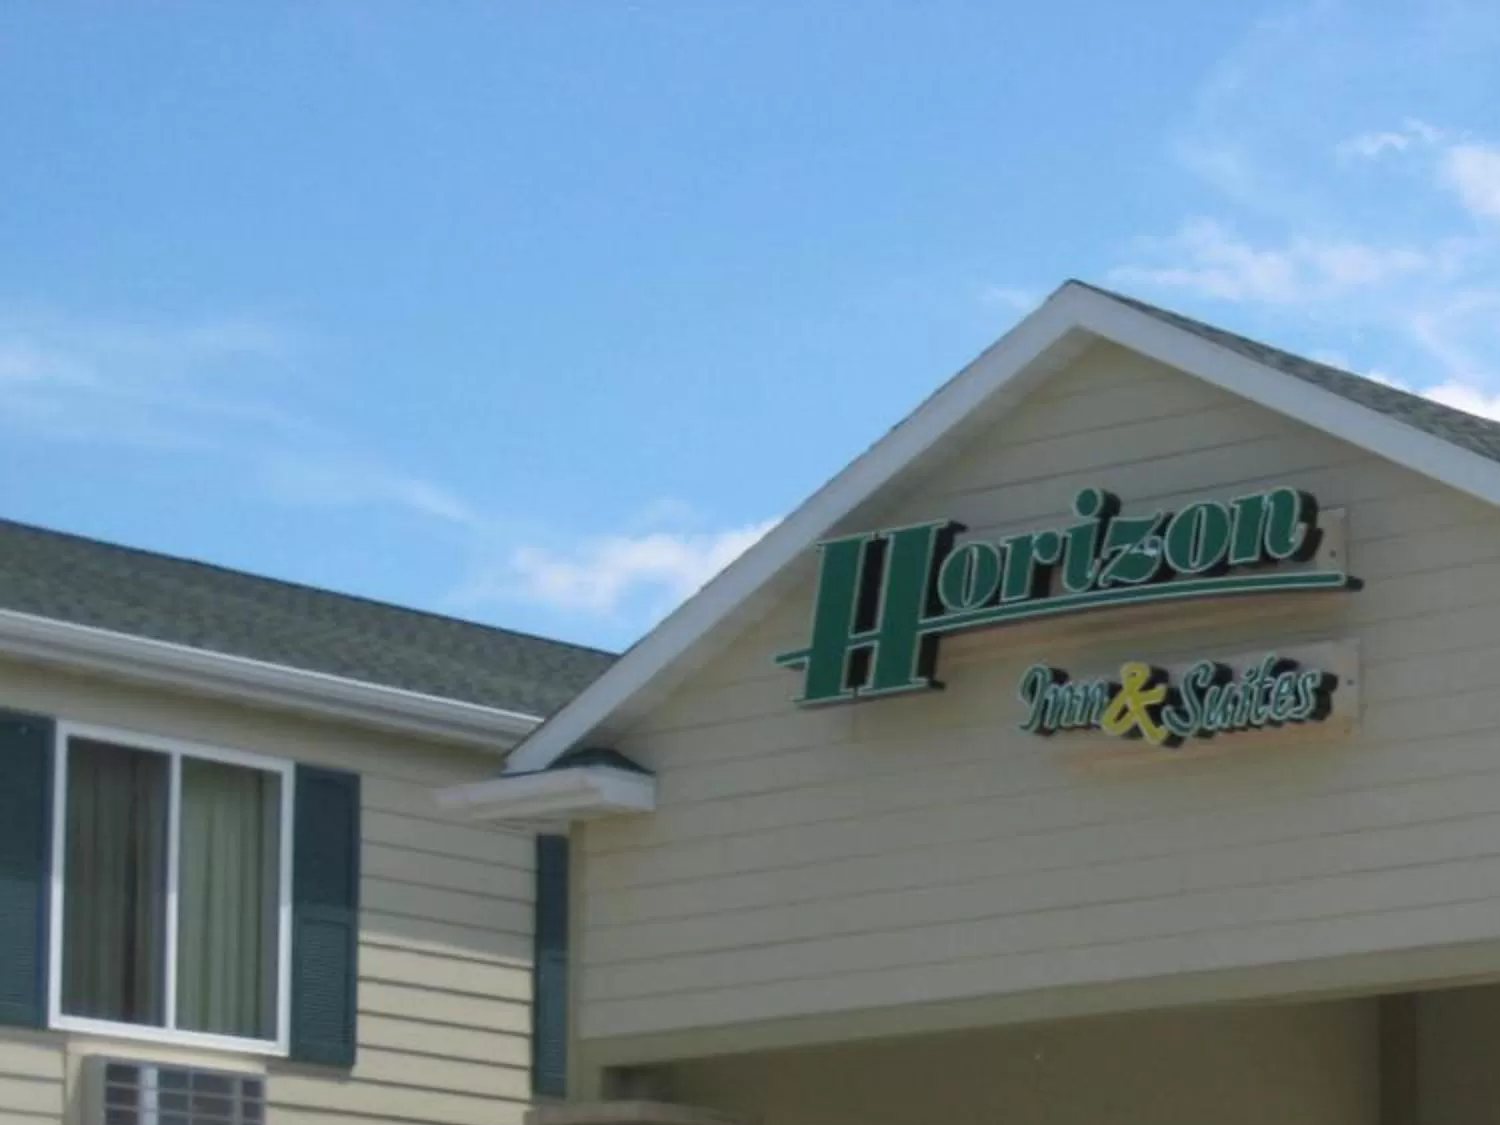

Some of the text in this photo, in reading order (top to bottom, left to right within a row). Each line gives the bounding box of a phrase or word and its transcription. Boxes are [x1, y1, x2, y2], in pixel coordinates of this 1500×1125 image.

[785, 486, 1314, 706] Horizon
[1018, 654, 1320, 746] Inn & Suites
